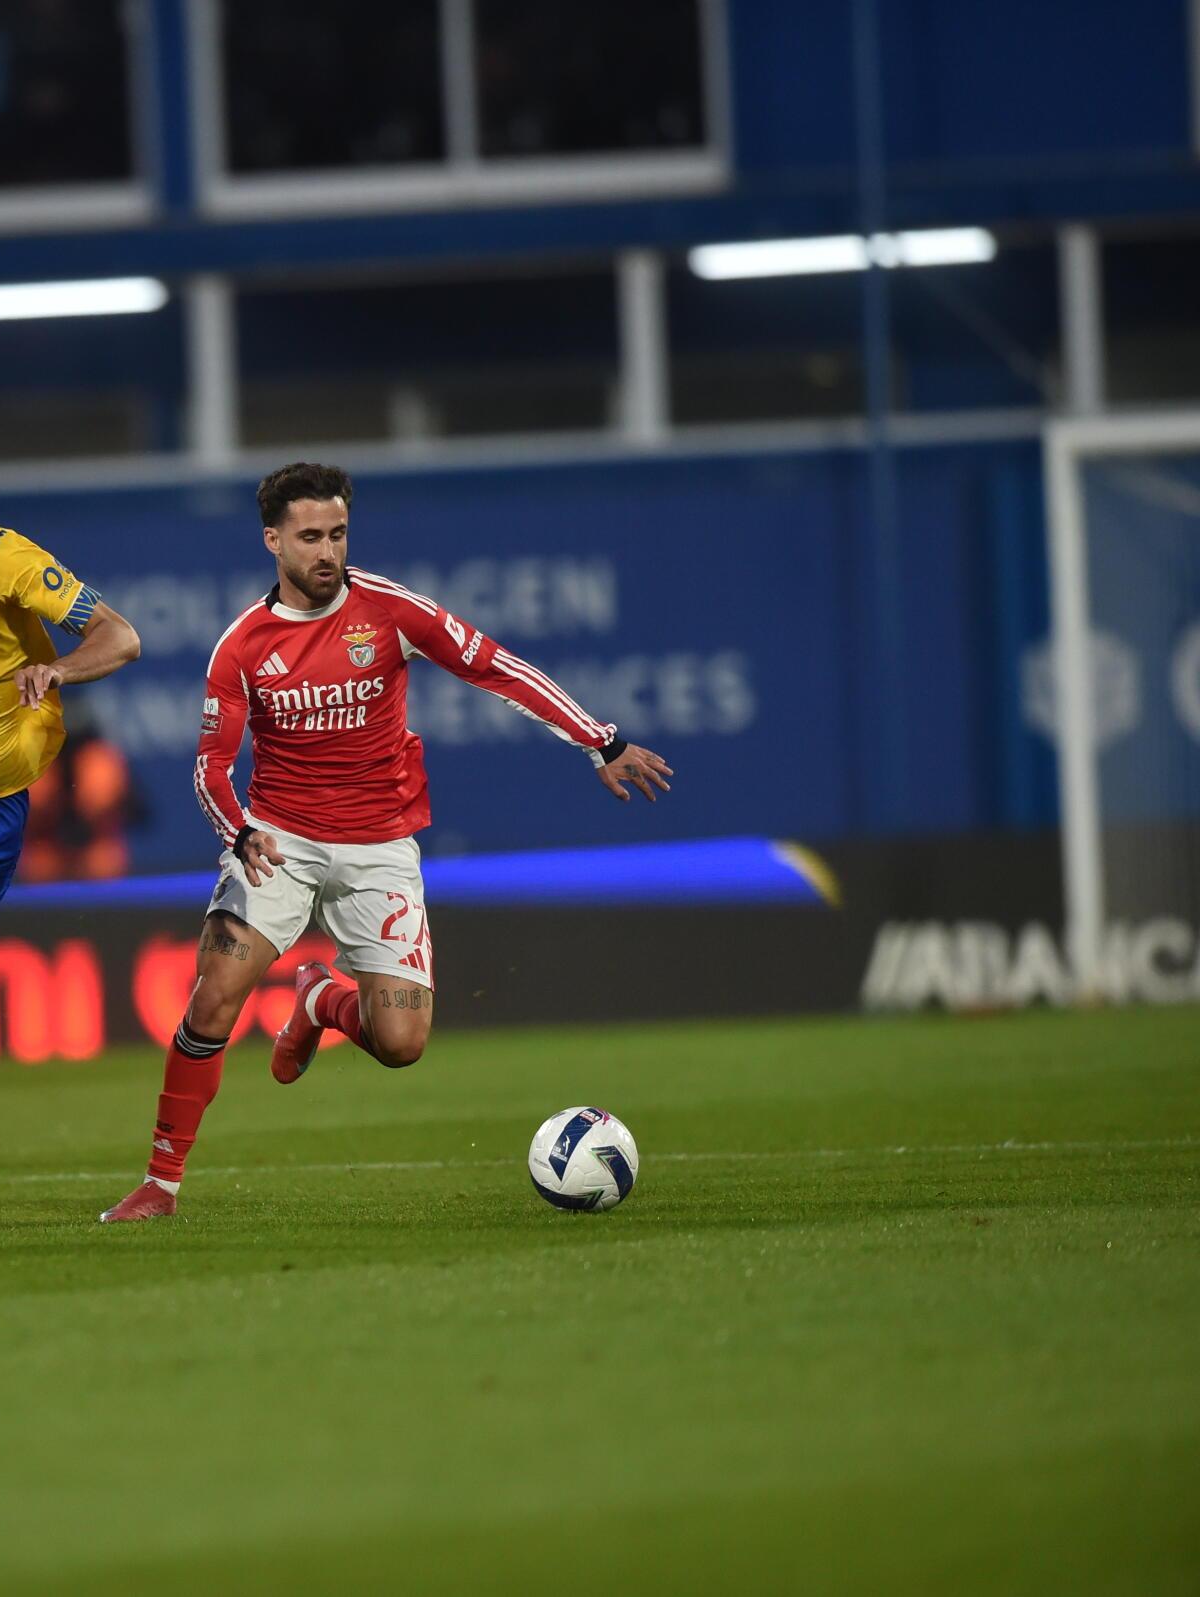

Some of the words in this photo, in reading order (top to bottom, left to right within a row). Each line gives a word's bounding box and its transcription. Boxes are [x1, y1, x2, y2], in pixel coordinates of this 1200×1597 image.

[257, 677, 384, 711] Emirates
[275, 711, 300, 730] FLY
[305, 705, 366, 731] BETTER
